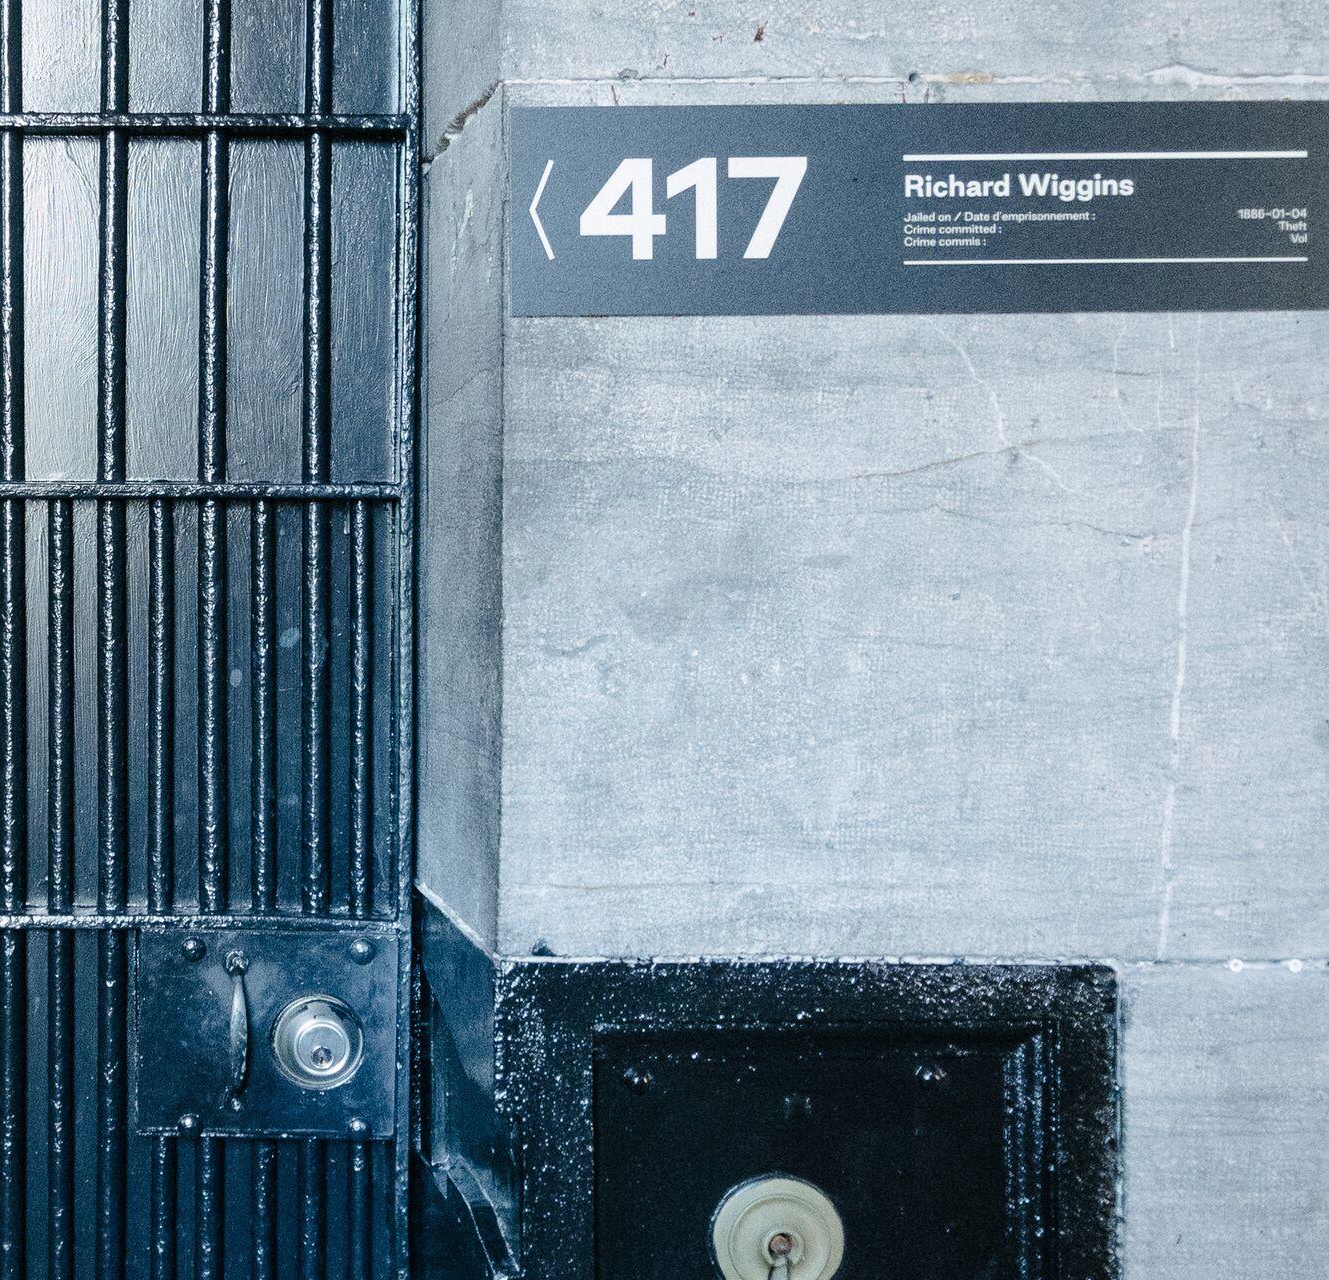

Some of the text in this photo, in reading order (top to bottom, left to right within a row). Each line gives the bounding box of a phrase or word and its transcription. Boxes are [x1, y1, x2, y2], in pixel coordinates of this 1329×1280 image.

[904, 173, 1135, 202] Richard Wiggins
[579, 156, 808, 260] 417
[904, 212, 935, 222] Jailed
[938, 214, 951, 222] on
[964, 212, 990, 221] Date
[904, 225, 936, 235] Crime
[1278, 221, 1307, 231] Theft
[904, 237, 936, 247] Crime
[1290, 233, 1308, 243] Vol
